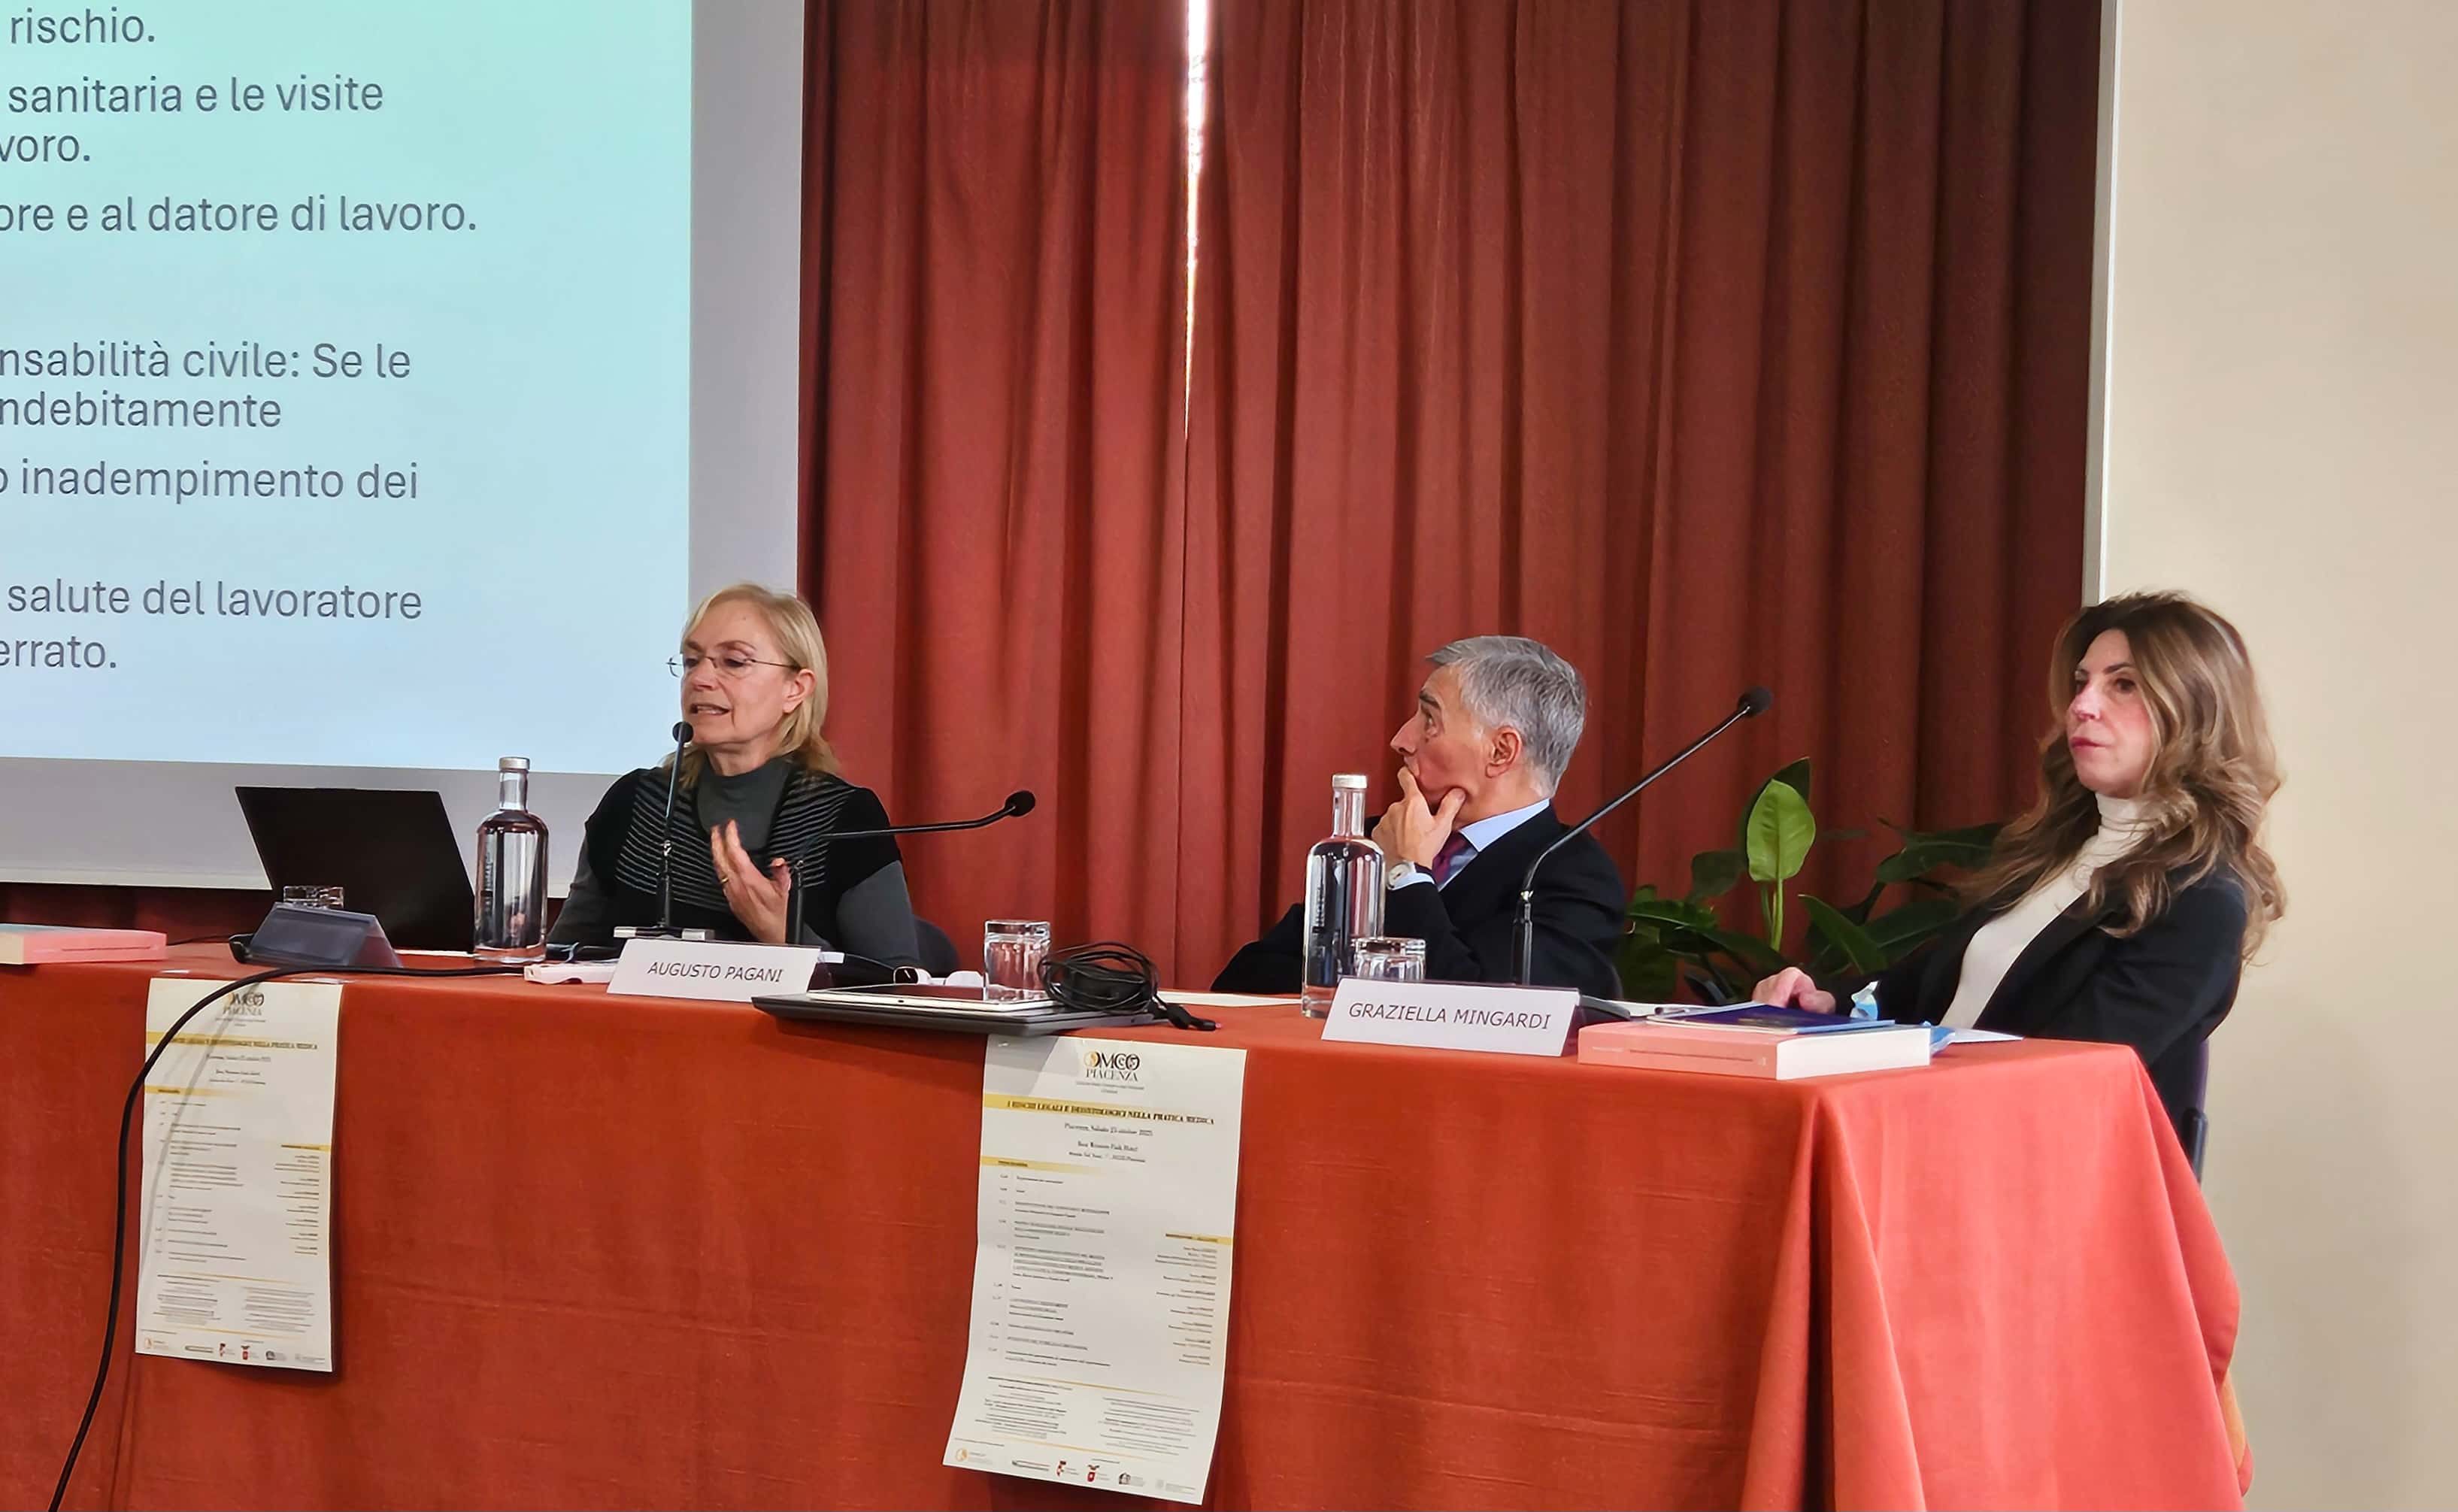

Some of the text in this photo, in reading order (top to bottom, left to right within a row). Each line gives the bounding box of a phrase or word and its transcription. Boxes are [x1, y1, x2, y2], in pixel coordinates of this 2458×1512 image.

[11, 6, 156, 44] rischio.
[8, 73, 383, 114] sanitaria e le visite
[66, 204, 89, 232] e
[101, 195, 138, 232] al
[148, 195, 278, 232] datore
[291, 193, 326, 232] di
[340, 195, 476, 232] lavoro.
[183, 340, 300, 378] civile:
[312, 342, 362, 378] Se
[376, 343, 411, 379] le
[22, 456, 344, 505] inadempimento
[356, 462, 417, 499] dei
[8, 577, 422, 620] salute del lavoratore
[647, 962, 783, 983] AUGUSTO PAGANI
[1349, 1002, 1552, 1030] GRAZIELLA MINGARDI
[1085, 1068, 1138, 1082] PIACENZA
[1127, 1109, 1151, 1120] NELLA
[1153, 1113, 1184, 1123] PRATICA
